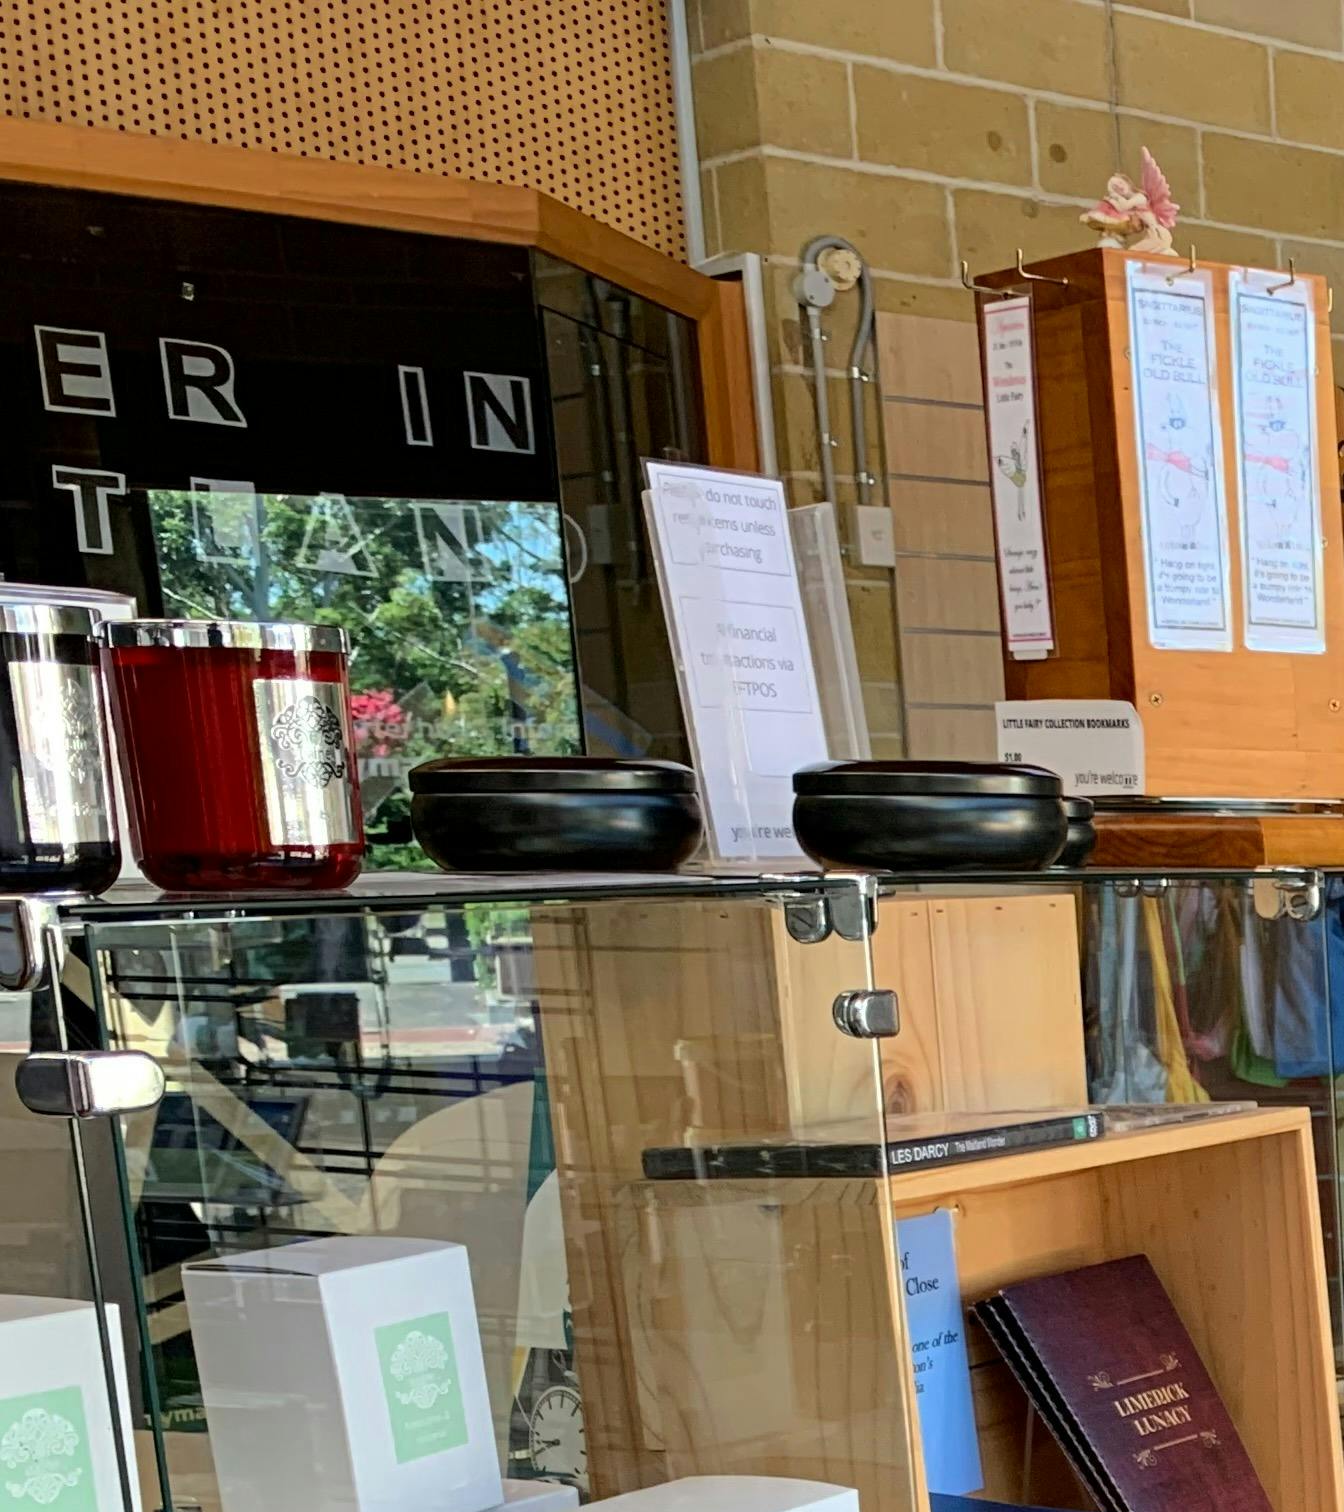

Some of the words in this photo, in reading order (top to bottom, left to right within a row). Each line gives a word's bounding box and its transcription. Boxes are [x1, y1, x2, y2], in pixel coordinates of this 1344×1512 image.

[398, 365, 535, 454] IN
[723, 492, 743, 507] not
[745, 494, 777, 511] touch
[741, 522, 776, 537] unless
[778, 657, 795, 671] via
[1003, 719, 1023, 729] LITTLE
[1024, 719, 1042, 729] FAIRY
[1045, 719, 1085, 729] COLLECTION
[1087, 719, 1130, 729] BOOKMARKS
[1004, 752, 1022, 762] $1.00
[1075, 770, 1098, 787] you're
[891, 1148, 912, 1165] LES
[914, 1142, 951, 1161] DARCY
[955, 1141, 966, 1153] The
[966, 1138, 987, 1151] Maitland
[906, 1276, 939, 1296] Close
[912, 1341, 929, 1353] one
[932, 1331, 943, 1348] of
[944, 1330, 959, 1344] the
[1114, 1382, 1191, 1418] LIMERICK
[1134, 1405, 1192, 1436] LUNACY
